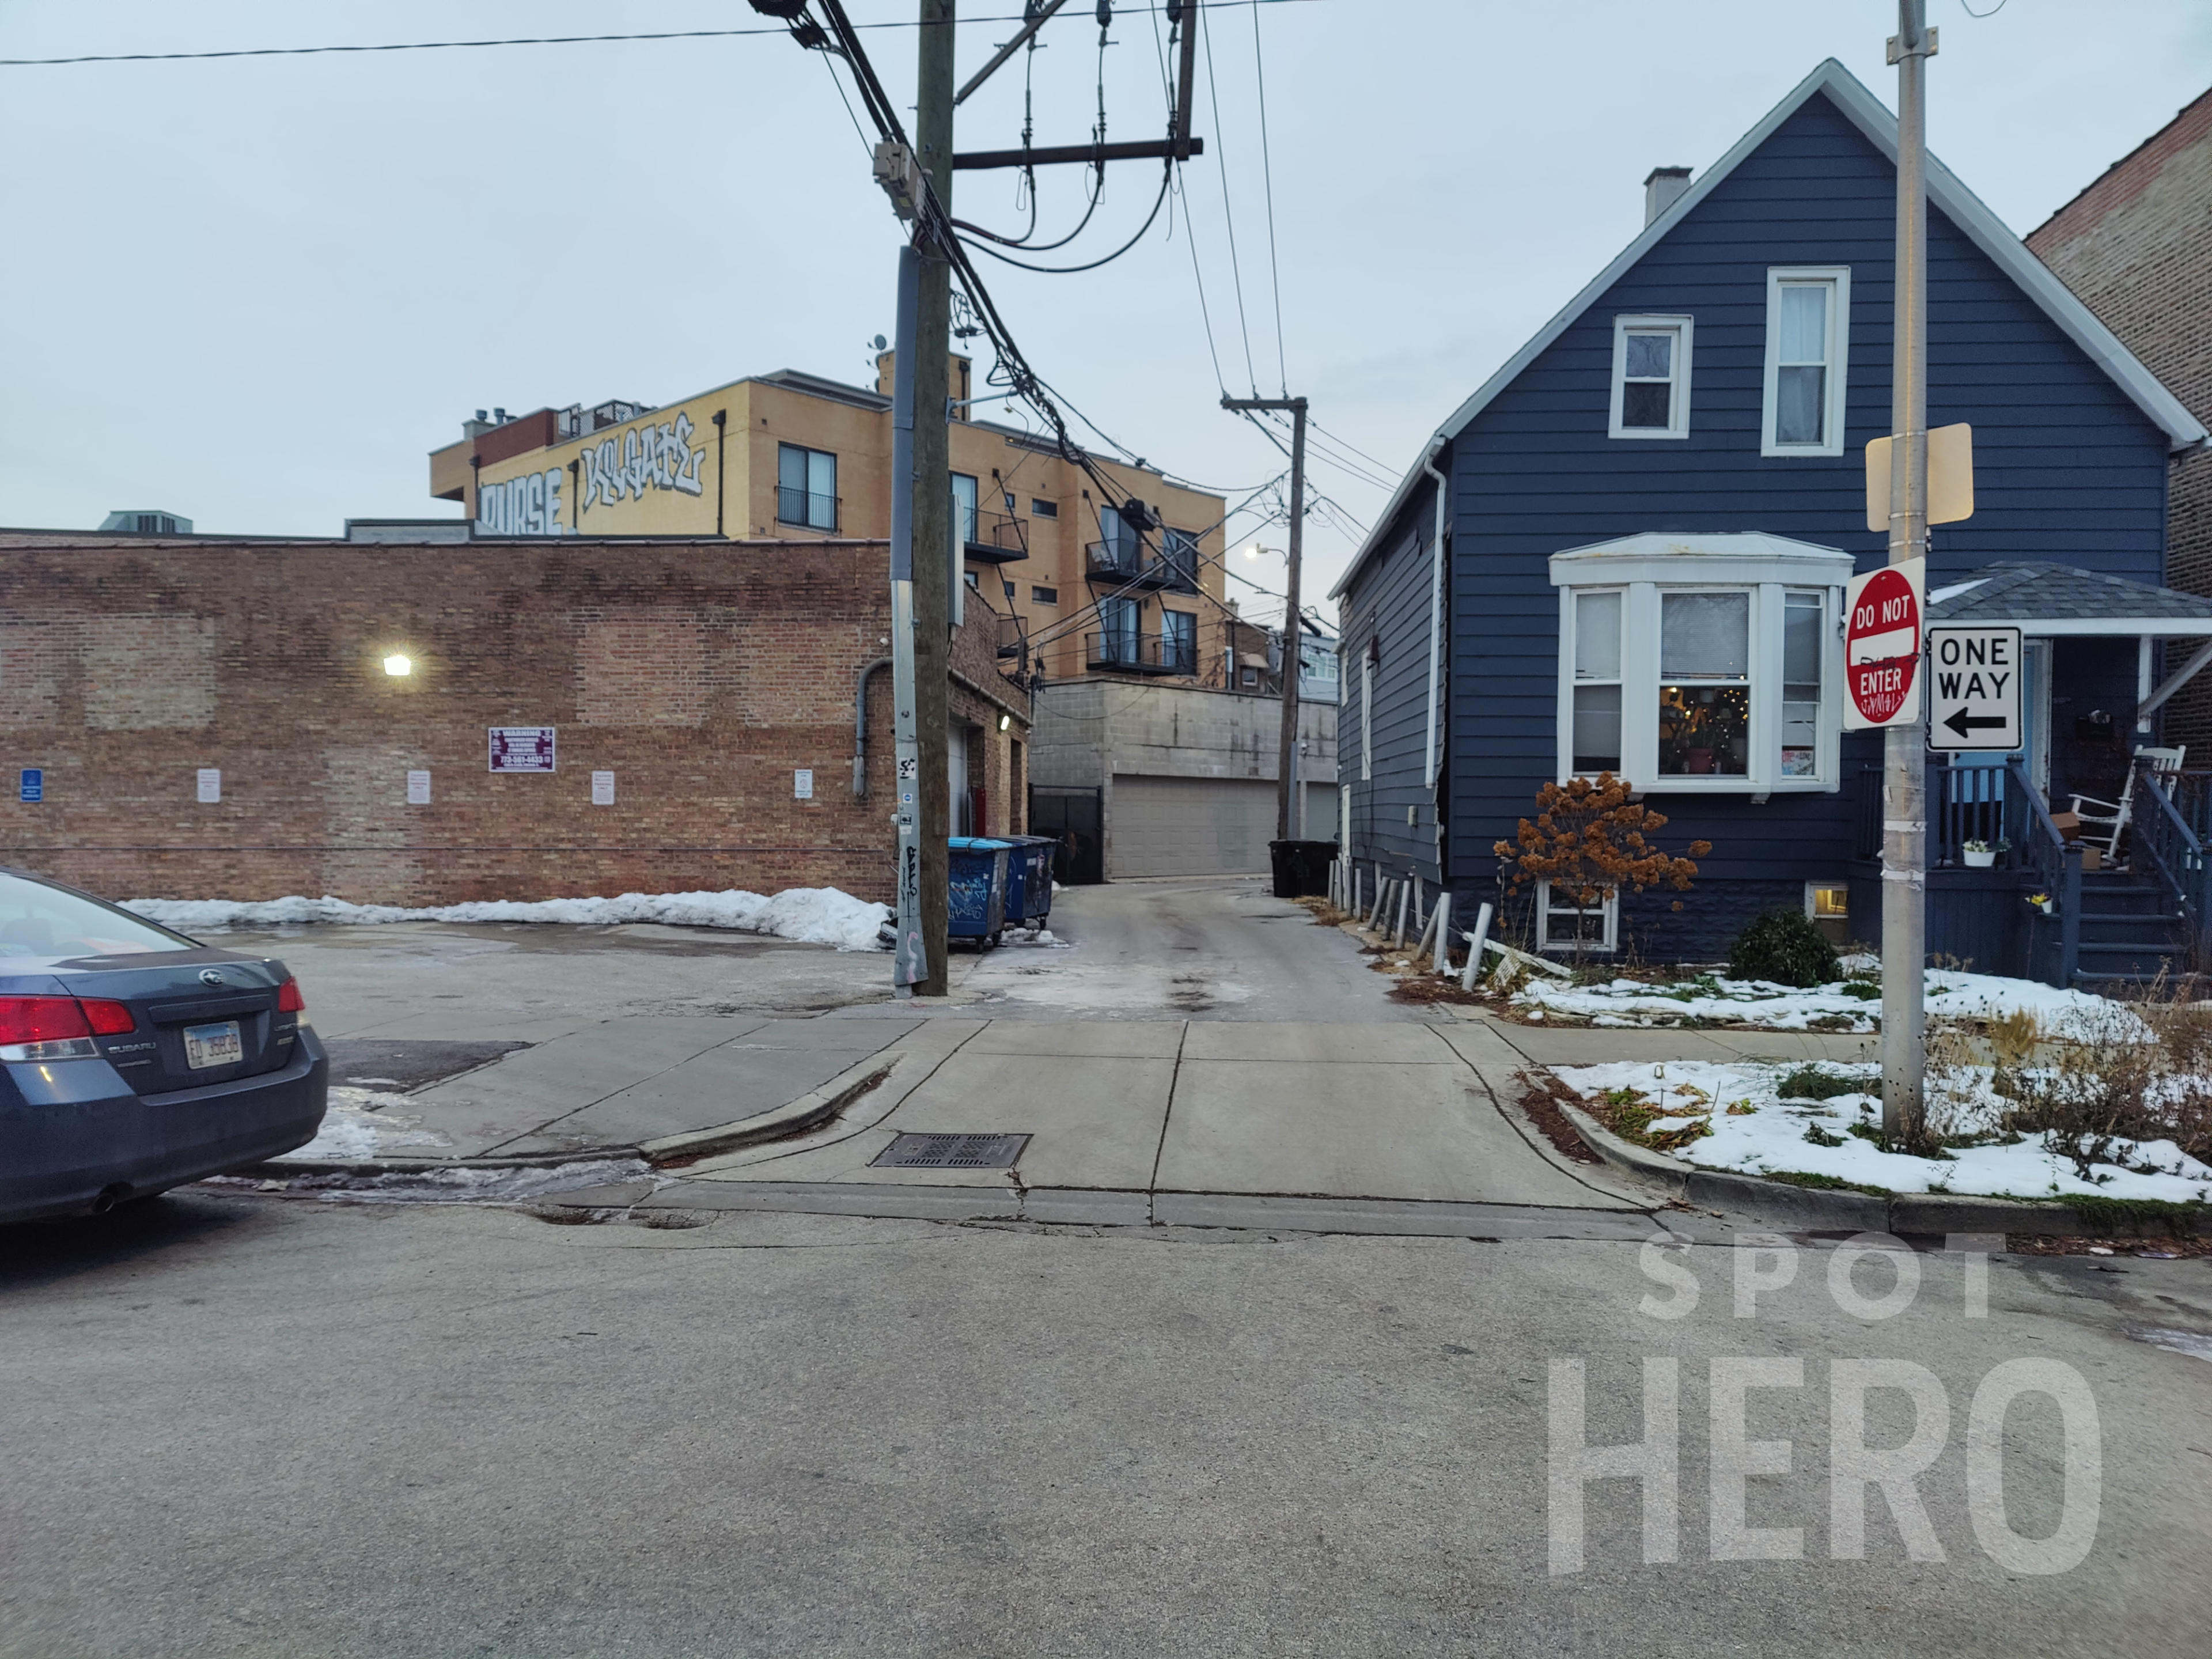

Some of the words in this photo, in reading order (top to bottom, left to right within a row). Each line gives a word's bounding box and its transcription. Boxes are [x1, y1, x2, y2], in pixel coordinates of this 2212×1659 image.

[1857, 604, 1874, 630] DO
[1883, 594, 1910, 624] NOT
[1941, 638, 2008, 665] ONE
[1861, 668, 1902, 695] ENTER
[1938, 672, 2010, 699] WAY
[108, 1042, 156, 1054] SUBARU
